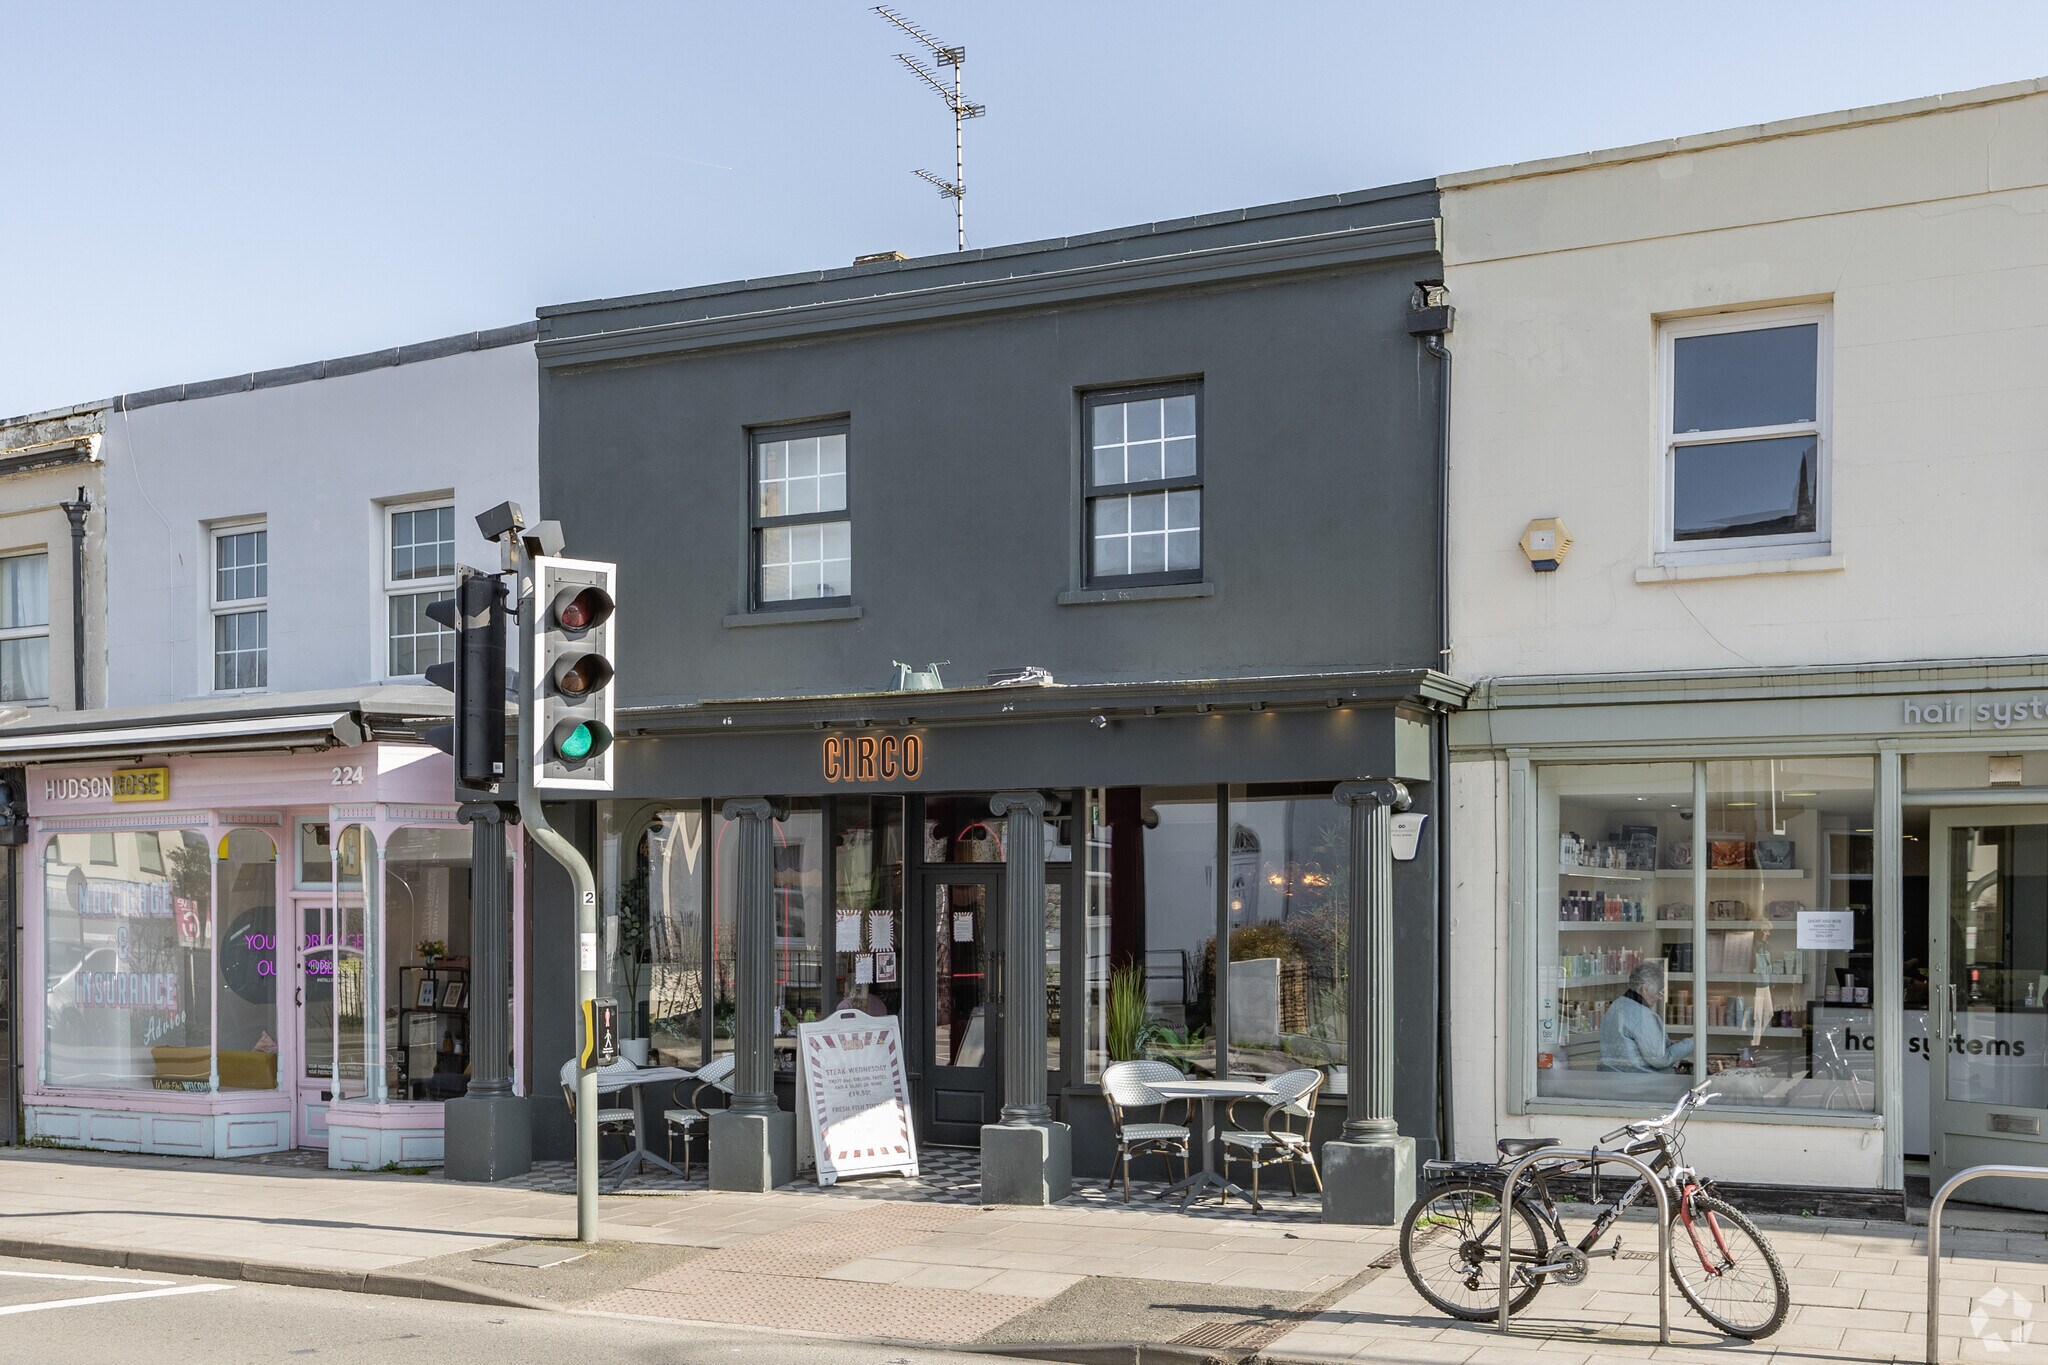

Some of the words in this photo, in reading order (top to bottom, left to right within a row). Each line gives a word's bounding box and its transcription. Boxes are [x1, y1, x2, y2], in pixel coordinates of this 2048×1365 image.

[1904, 699, 1964, 724] hair
[1976, 696, 2048, 729] syst
[823, 734, 923, 783] CIRCO
[331, 766, 364, 785] 224
[78, 881, 174, 918] MORTGAGE
[585, 892, 594, 904] 2
[245, 934, 276, 950] YOU
[75, 972, 177, 1009] INSURANCE
[144, 1010, 187, 1045] Advice
[826, 1068, 846, 1076] STEAK
[848, 1065, 887, 1074] WEDNESDAY
